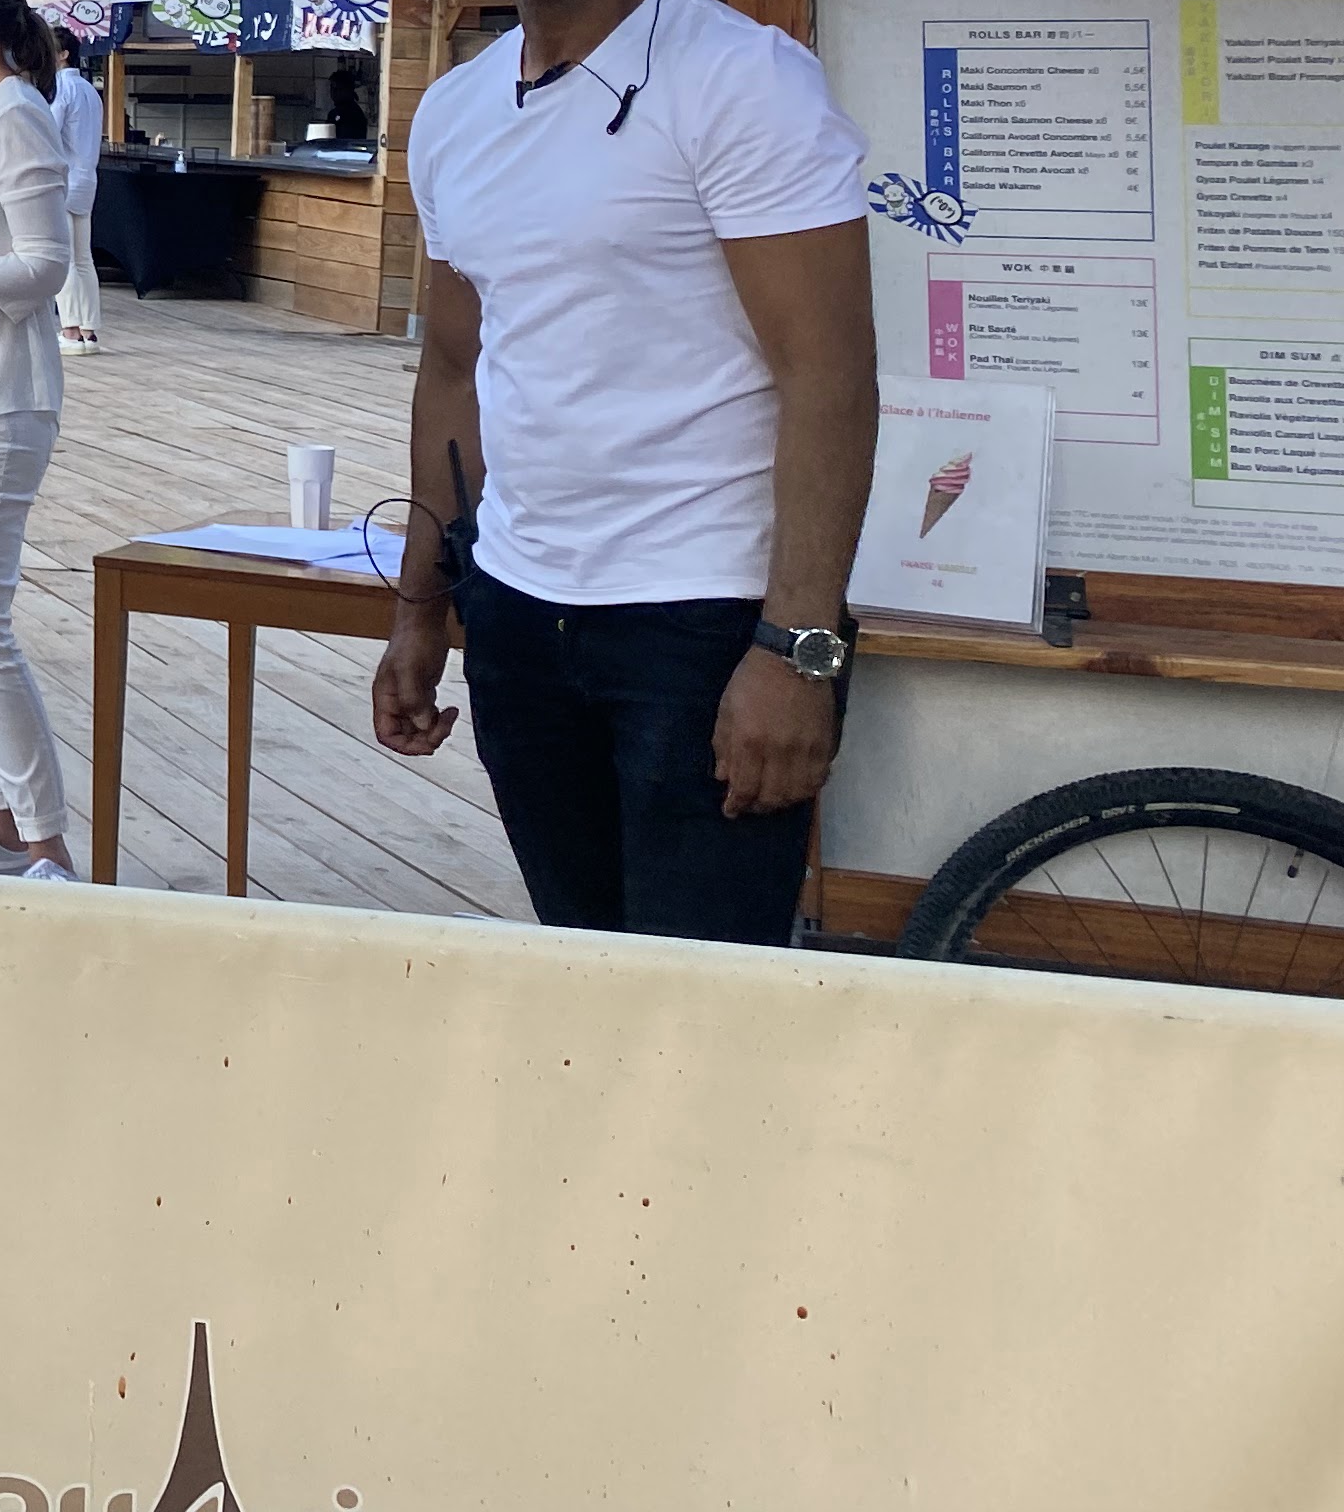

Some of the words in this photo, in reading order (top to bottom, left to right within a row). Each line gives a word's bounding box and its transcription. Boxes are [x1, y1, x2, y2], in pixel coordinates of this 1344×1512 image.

[969, 30, 1010, 39] ROLLS
[1015, 30, 1042, 39] BAR
[960, 66, 985, 75] Maki
[1047, 67, 1085, 75] Cheese
[961, 83, 985, 91] Maki
[987, 83, 1027, 91] Saumon
[961, 99, 985, 107] Maki
[987, 99, 1012, 107] Thon
[961, 116, 1009, 124] California
[1012, 116, 1052, 124] Saumon
[1055, 116, 1093, 124] Cheese
[962, 132, 1006, 141] California
[1007, 133, 1041, 141] Avocat
[962, 149, 1006, 157] California
[962, 166, 1010, 174] California
[1012, 166, 1038, 174] Thon
[1040, 166, 1075, 174] Avocat
[1002, 264, 1032, 272] WOK
[968, 294, 1009, 302] Nouilles
[969, 324, 985, 332] Riz
[970, 355, 989, 363] Pad
[1260, 351, 1285, 359] DIM
[1291, 352, 1321, 360] SUM
[880, 404, 913, 416] Glace
[1006, 815, 1090, 862] ROCKRIDER
